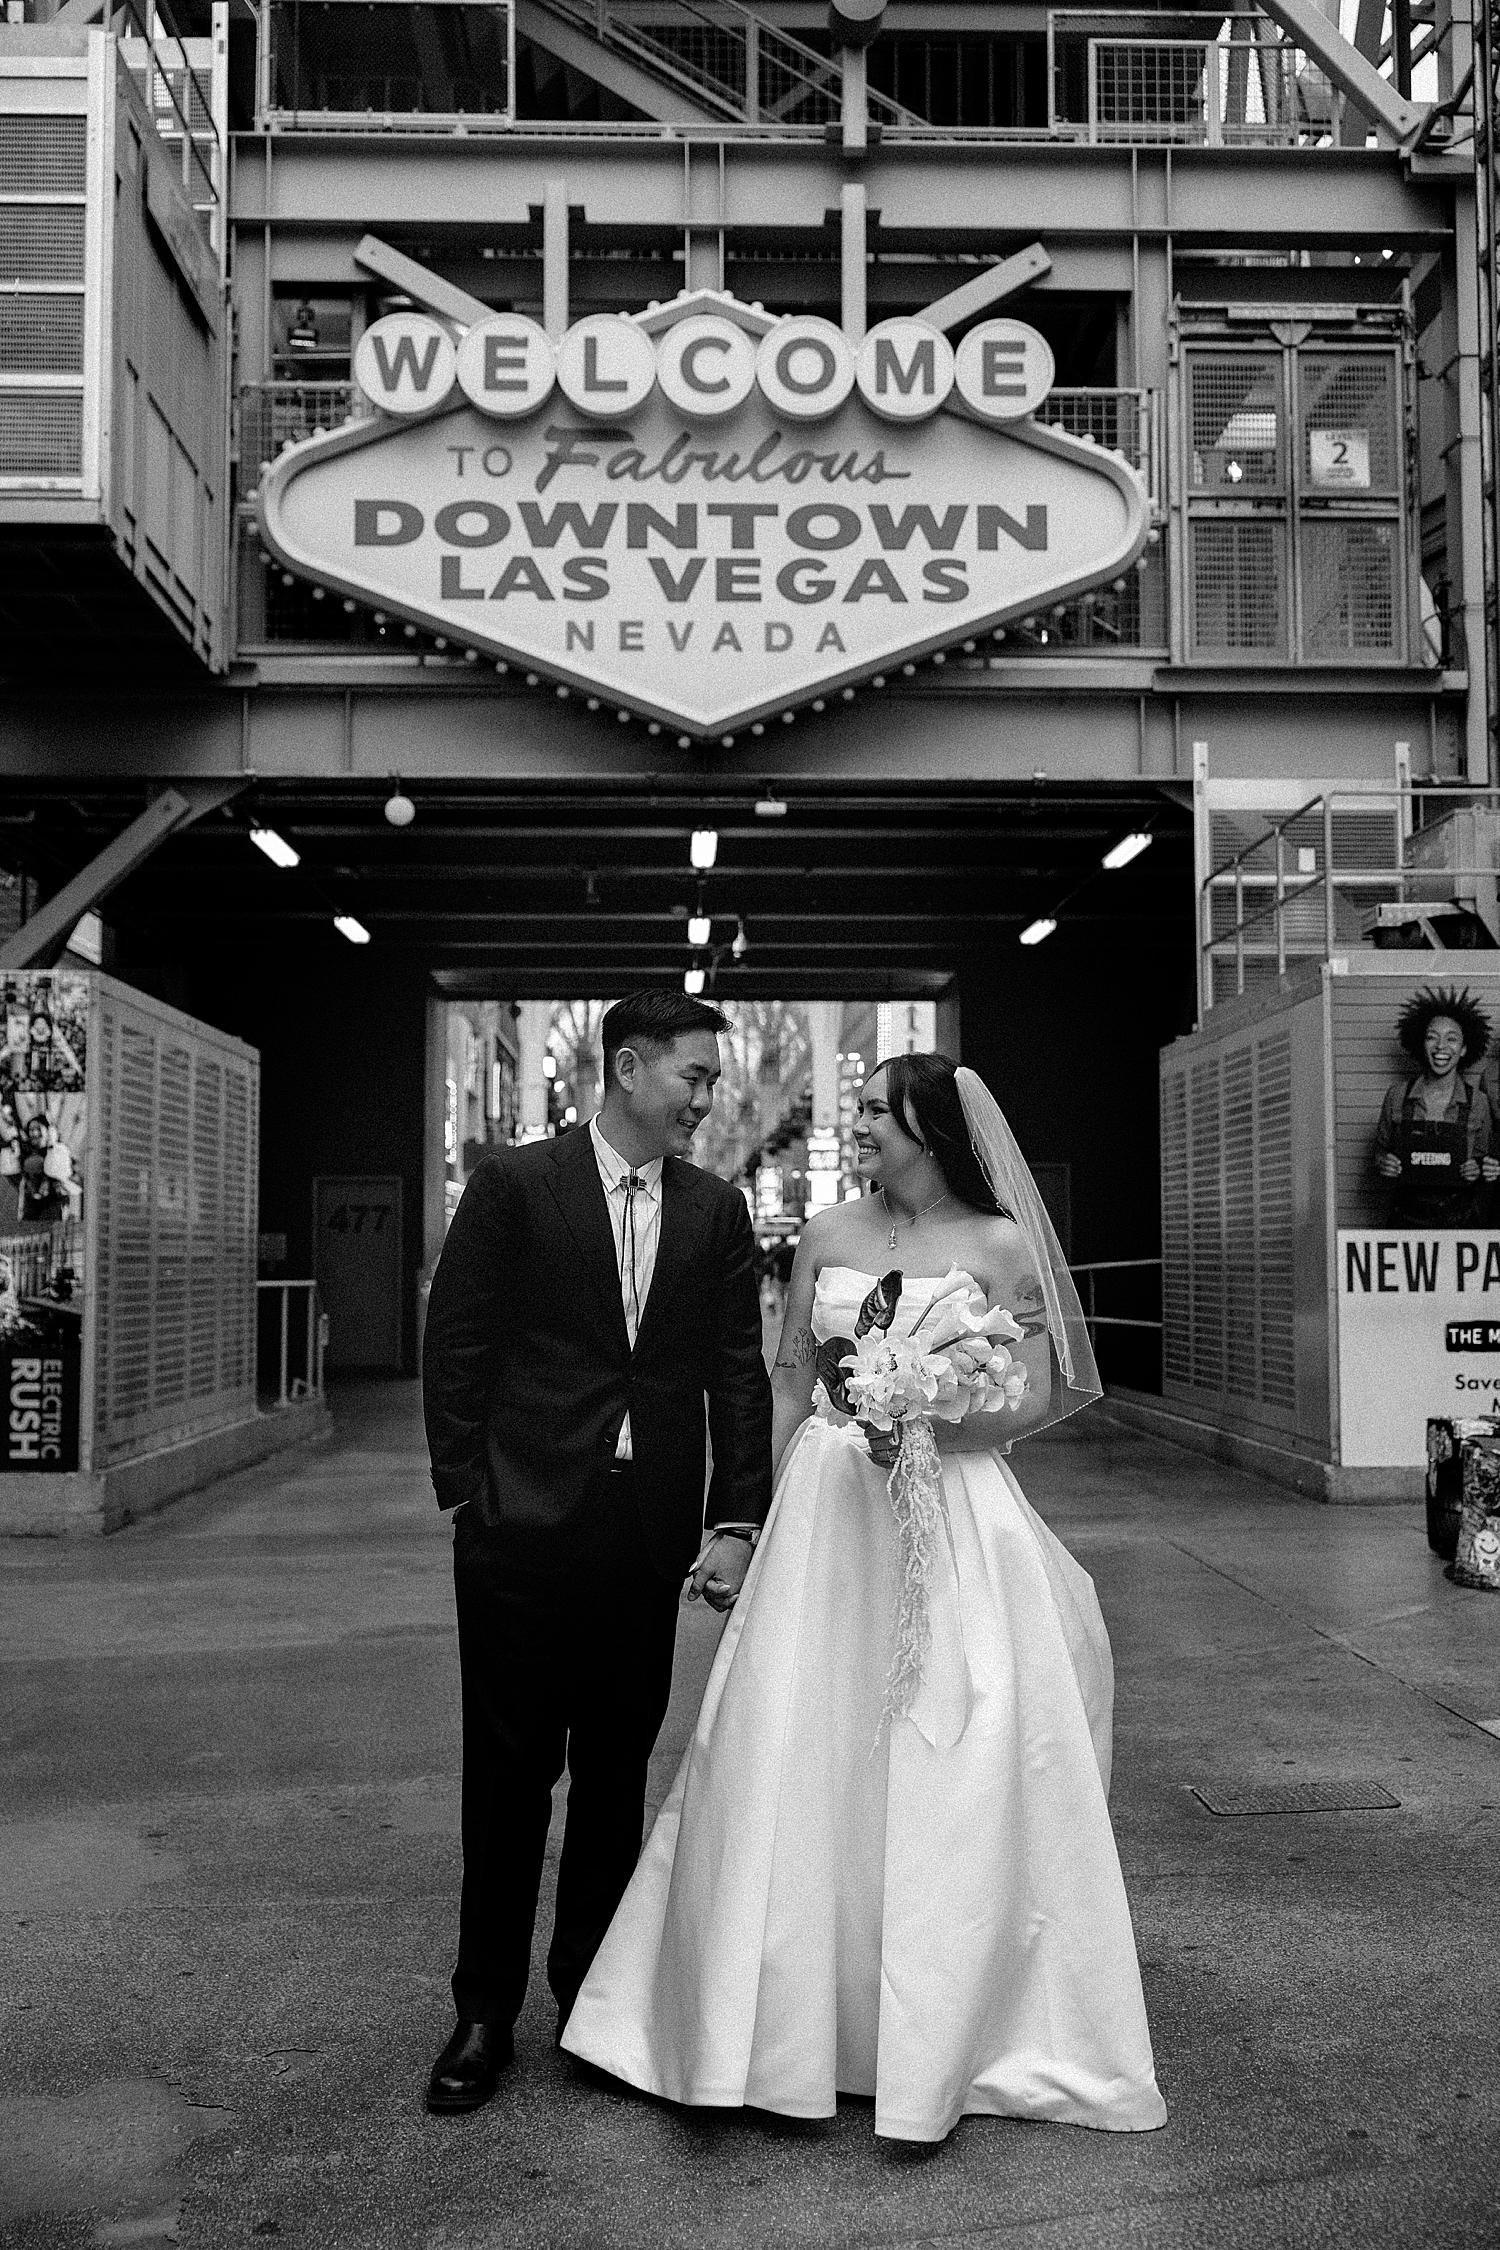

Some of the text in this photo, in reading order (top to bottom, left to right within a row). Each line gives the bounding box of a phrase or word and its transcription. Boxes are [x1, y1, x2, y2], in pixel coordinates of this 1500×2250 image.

[372, 335, 1028, 397] WELCOME
[447, 425, 911, 494] TO Fabulous
[1333, 441, 1348, 464] 2
[354, 500, 1048, 551] DOWNTOWN
[441, 556, 969, 605] LAS VEGAS
[567, 621, 846, 653] NEVADA
[327, 1204, 391, 1234] 477
[1346, 1241, 1440, 1293] NEW
[1449, 1328, 1483, 1345] THE
[9, 1358, 41, 1459] RUSH
[41, 1359, 63, 1460] ELECTRIC
